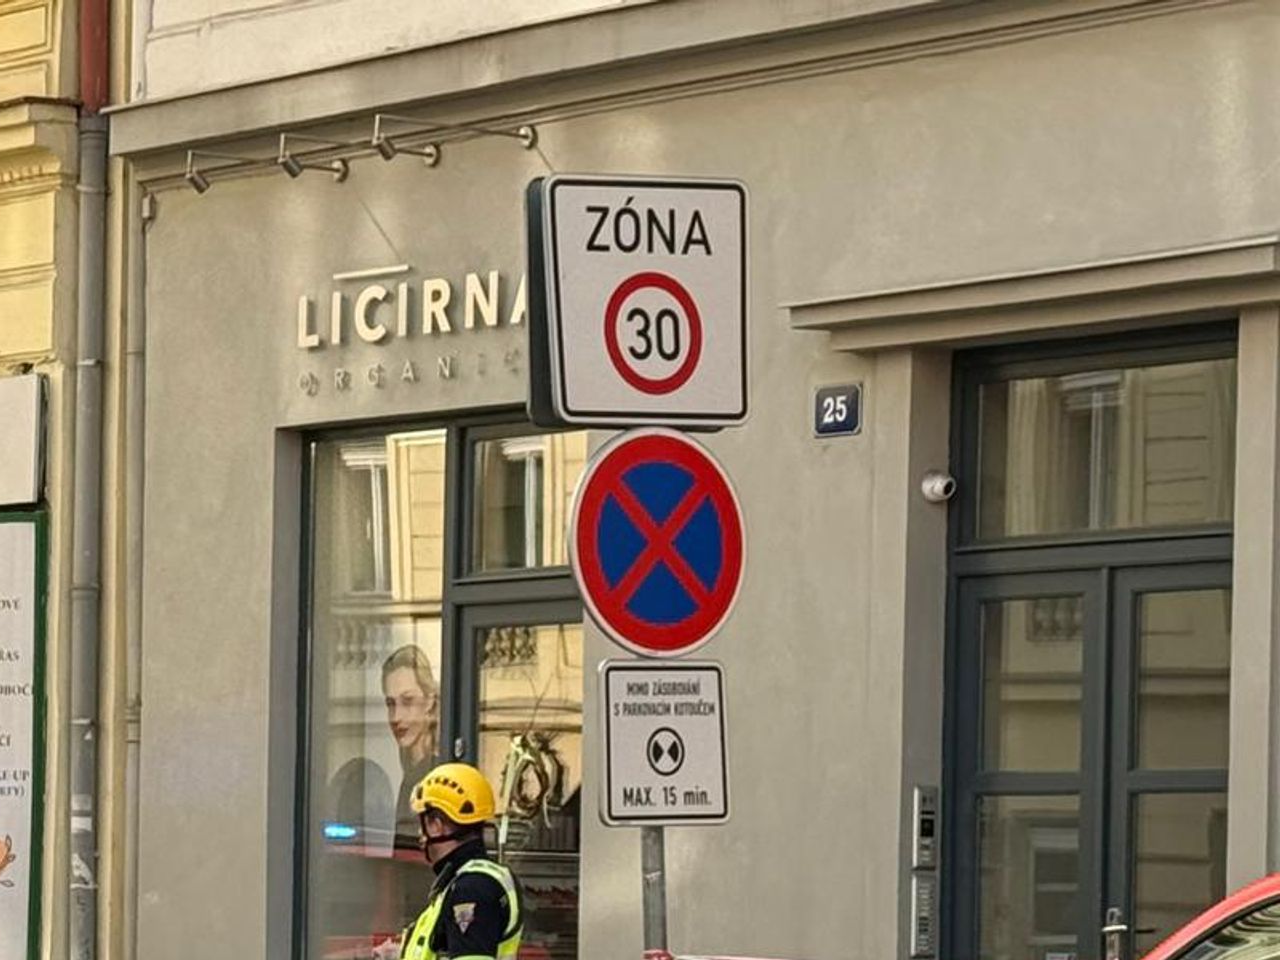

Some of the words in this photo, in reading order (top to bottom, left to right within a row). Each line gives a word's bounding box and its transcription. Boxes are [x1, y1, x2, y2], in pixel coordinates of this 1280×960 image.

[585, 196, 712, 255] ZÓNA
[627, 308, 680, 361] 30
[823, 396, 847, 423] 25
[613, 702, 620, 717] S
[623, 787, 657, 807] MAX.
[663, 786, 677, 806] 15
[683, 786, 712, 806] min.
